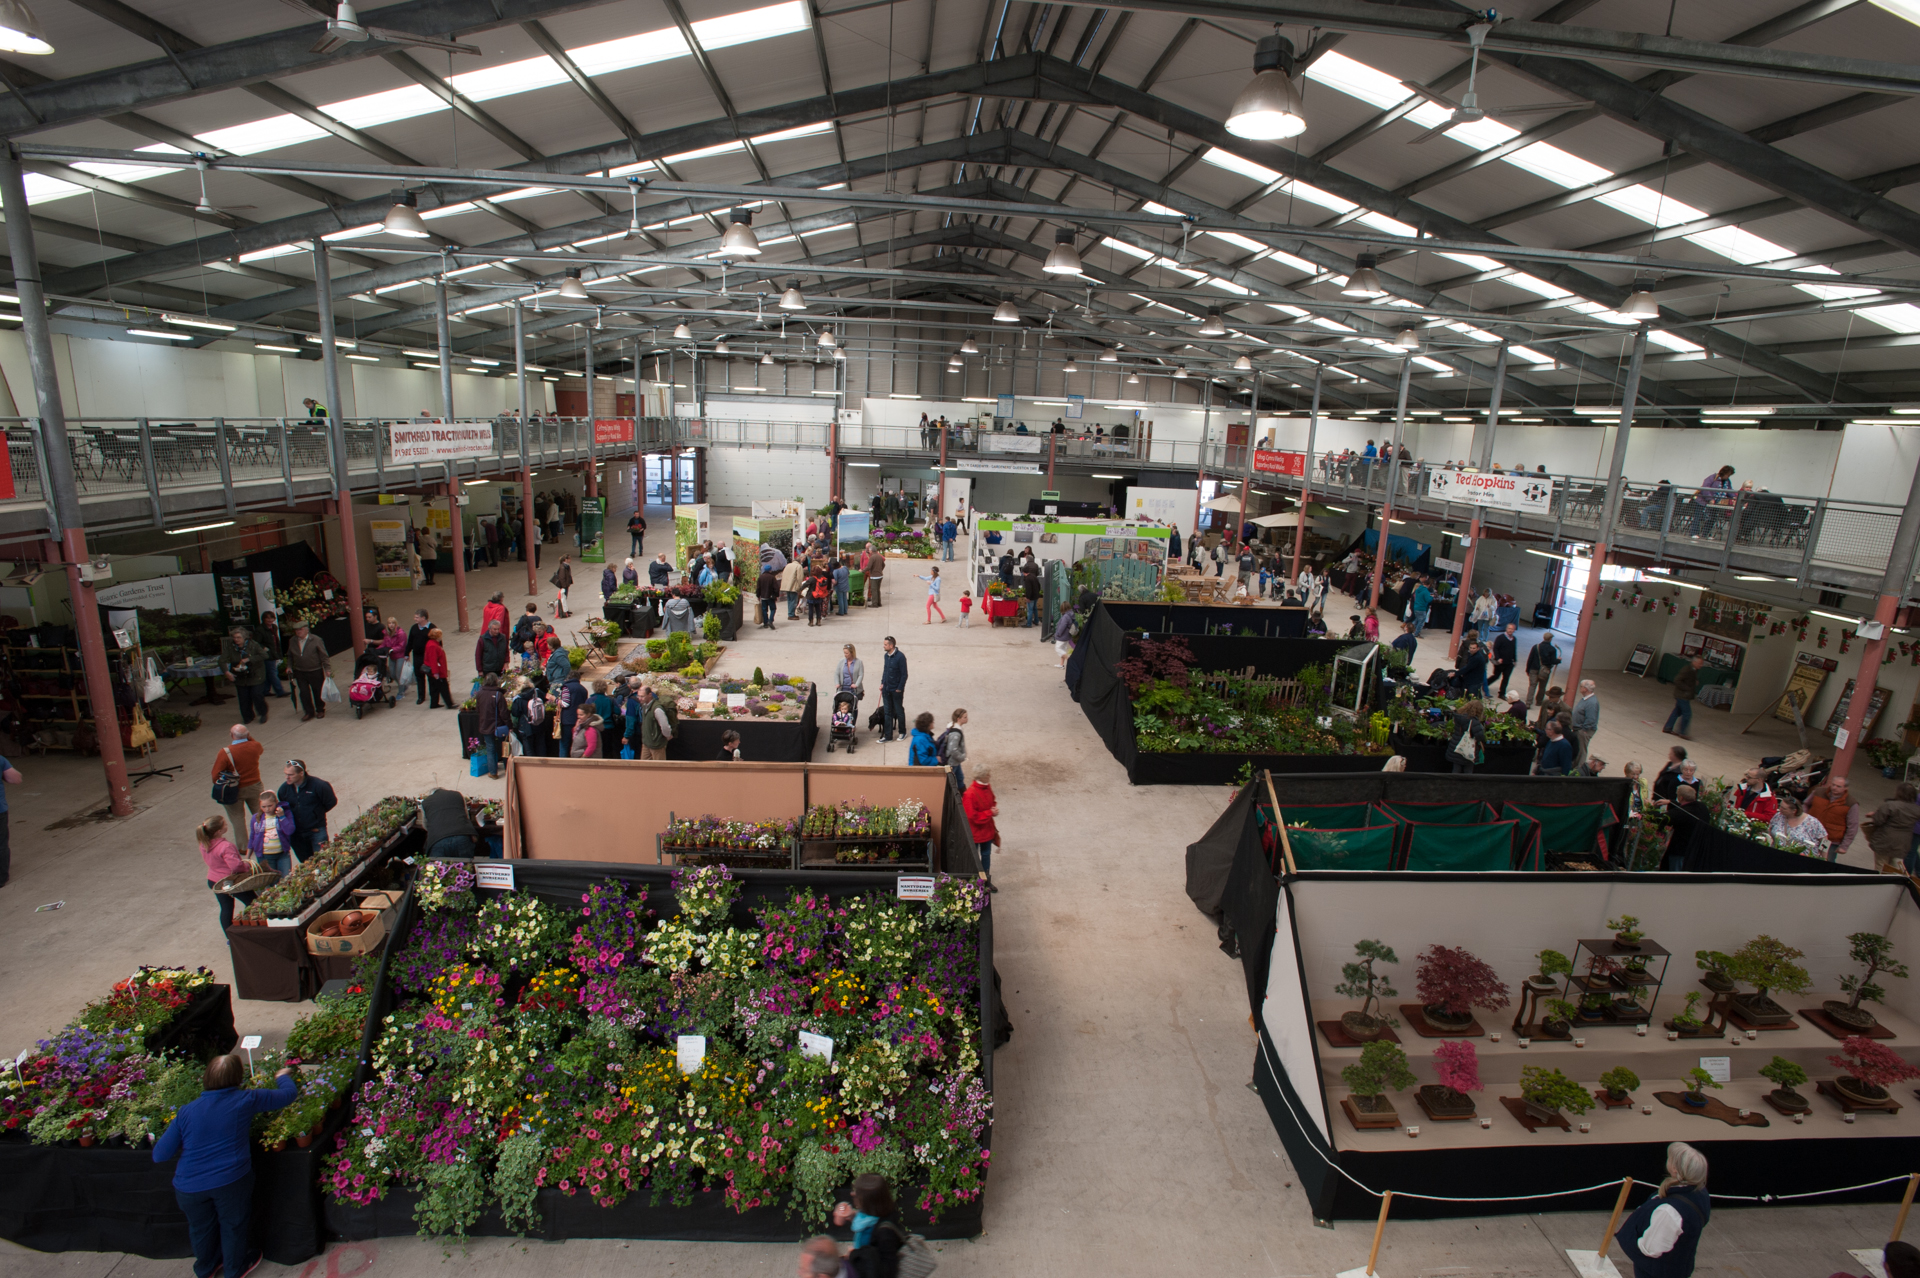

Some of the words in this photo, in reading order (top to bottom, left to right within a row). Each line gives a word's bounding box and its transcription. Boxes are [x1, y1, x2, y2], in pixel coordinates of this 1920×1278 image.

[394, 431, 431, 444] SMITHFIELD
[1456, 473, 1473, 486] Ted
[1472, 475, 1516, 491] Hopkins
[99, 592, 118, 604] Historic
[119, 587, 145, 598] Gardens
[146, 584, 165, 592] Trust
[1705, 597, 1760, 619] HEWNWOO
